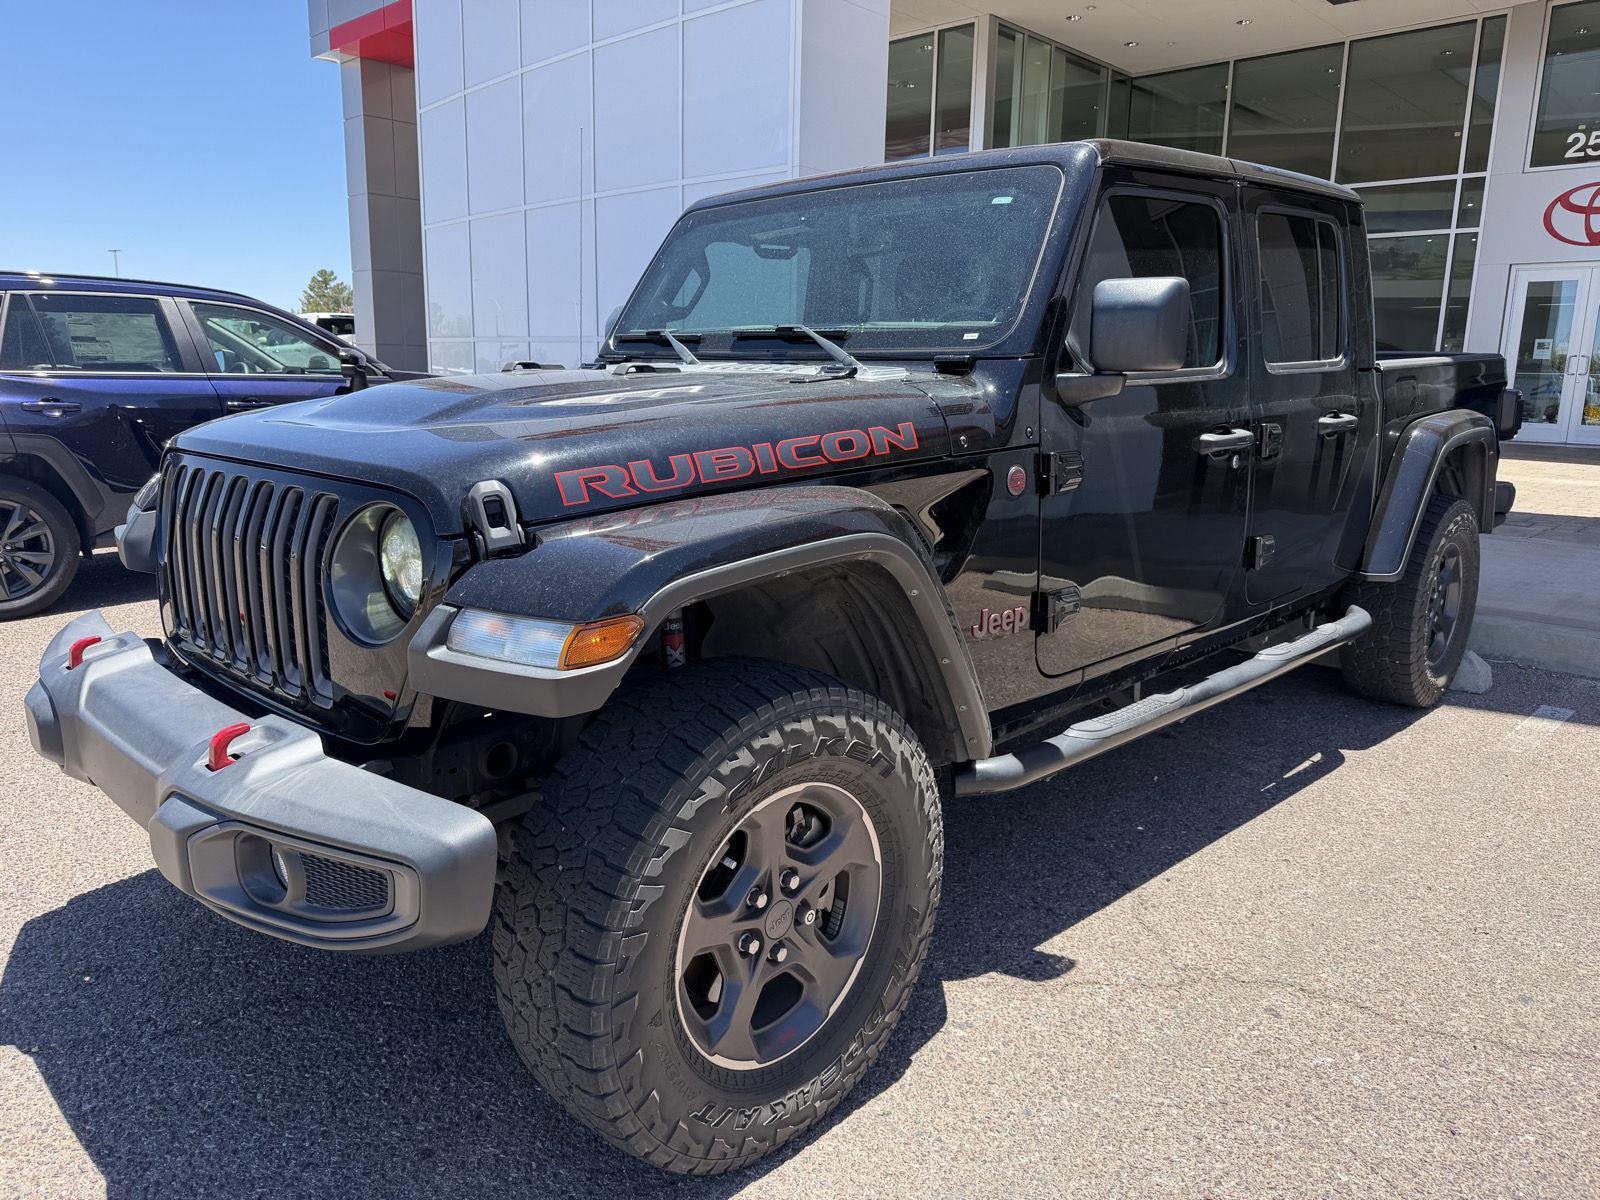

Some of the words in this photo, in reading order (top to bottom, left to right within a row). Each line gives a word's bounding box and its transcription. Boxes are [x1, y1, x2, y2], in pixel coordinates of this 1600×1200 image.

[553, 421, 920, 506] RUBICON
[970, 606, 1028, 639] Jeep
[721, 736, 897, 814] FALKEN
[769, 905, 791, 932] Jeep
